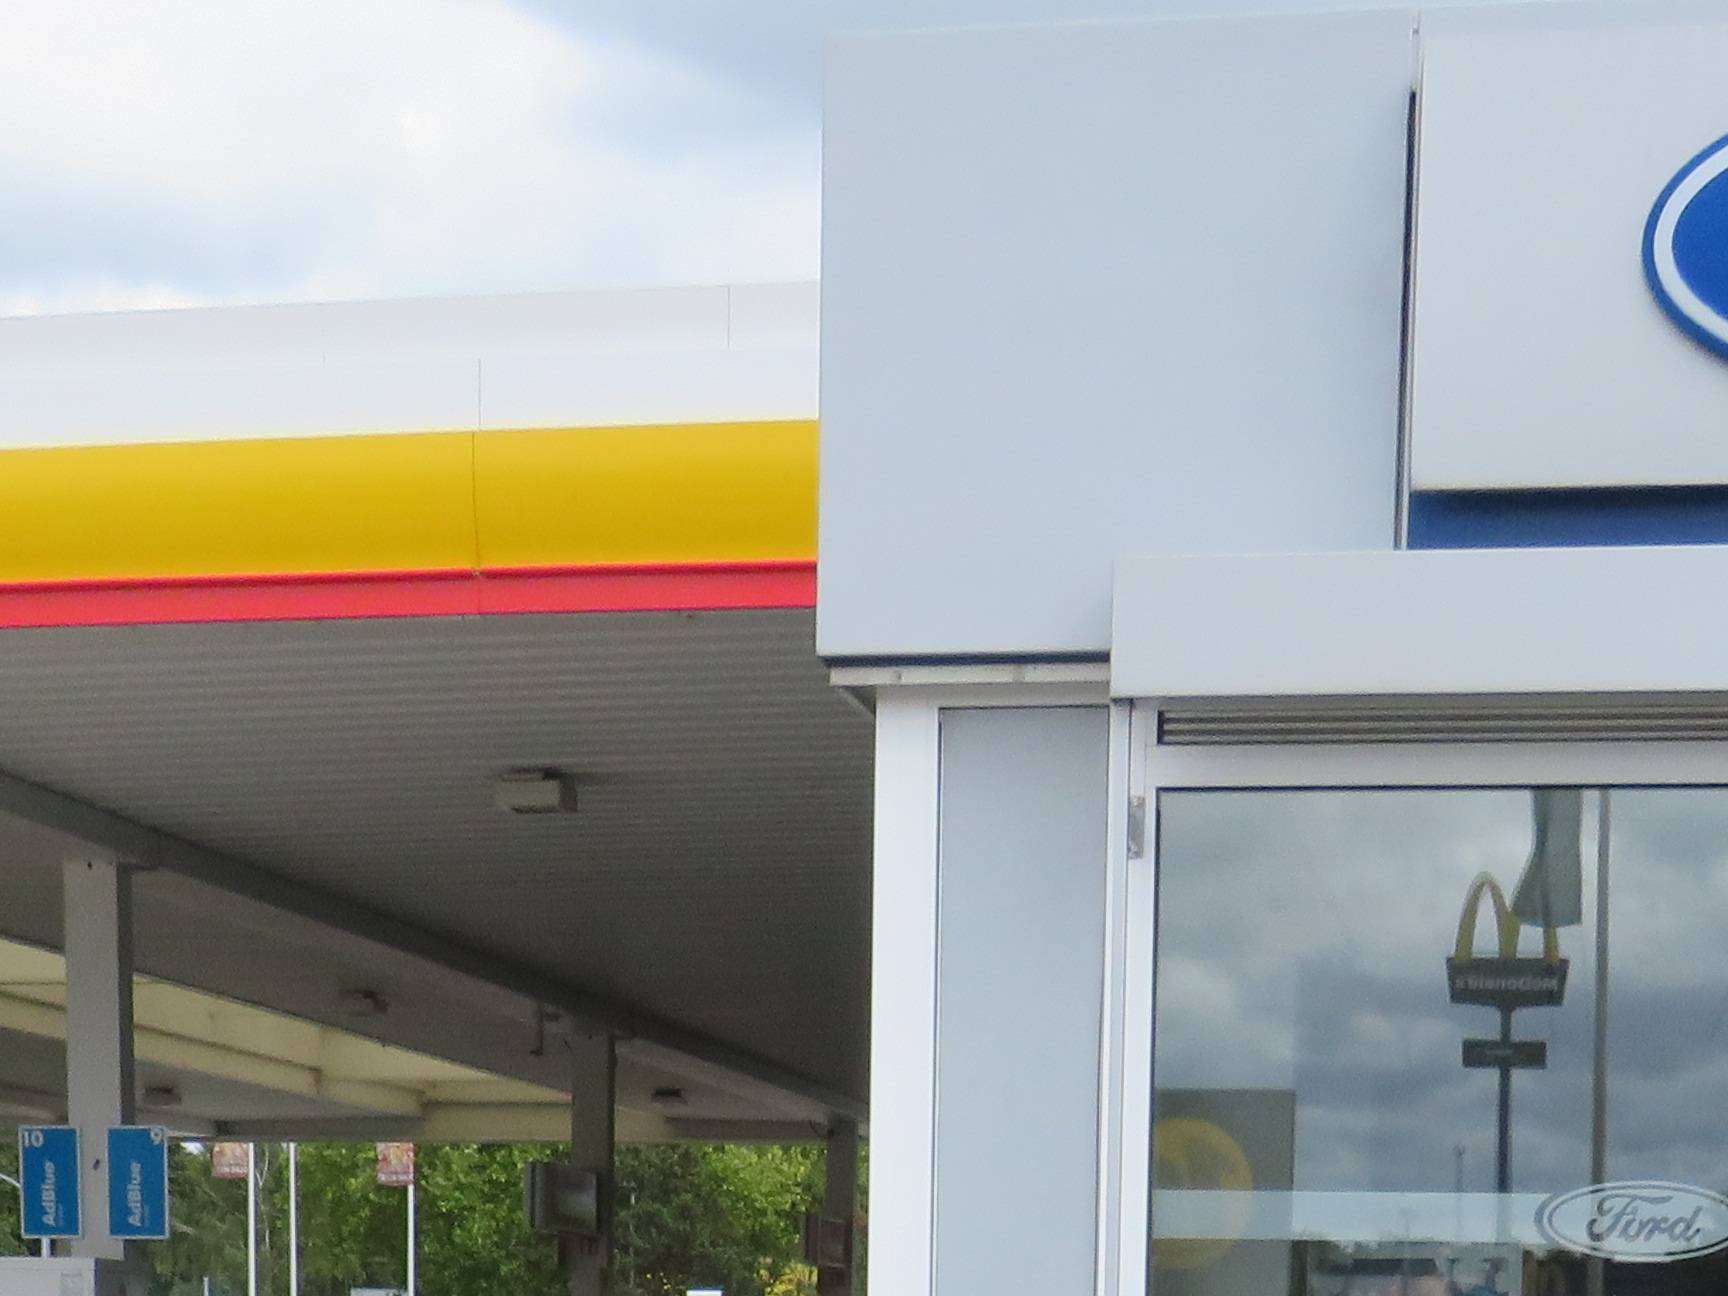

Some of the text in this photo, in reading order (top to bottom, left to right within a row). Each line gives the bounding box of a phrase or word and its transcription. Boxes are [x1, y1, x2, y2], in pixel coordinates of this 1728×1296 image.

[23, 1130, 44, 1148] 10
[149, 1130, 164, 1145] 9
[42, 1159, 56, 1228] AdBlue
[127, 1160, 142, 1228] AdBlue
[1585, 1194, 1703, 1243] Ford
